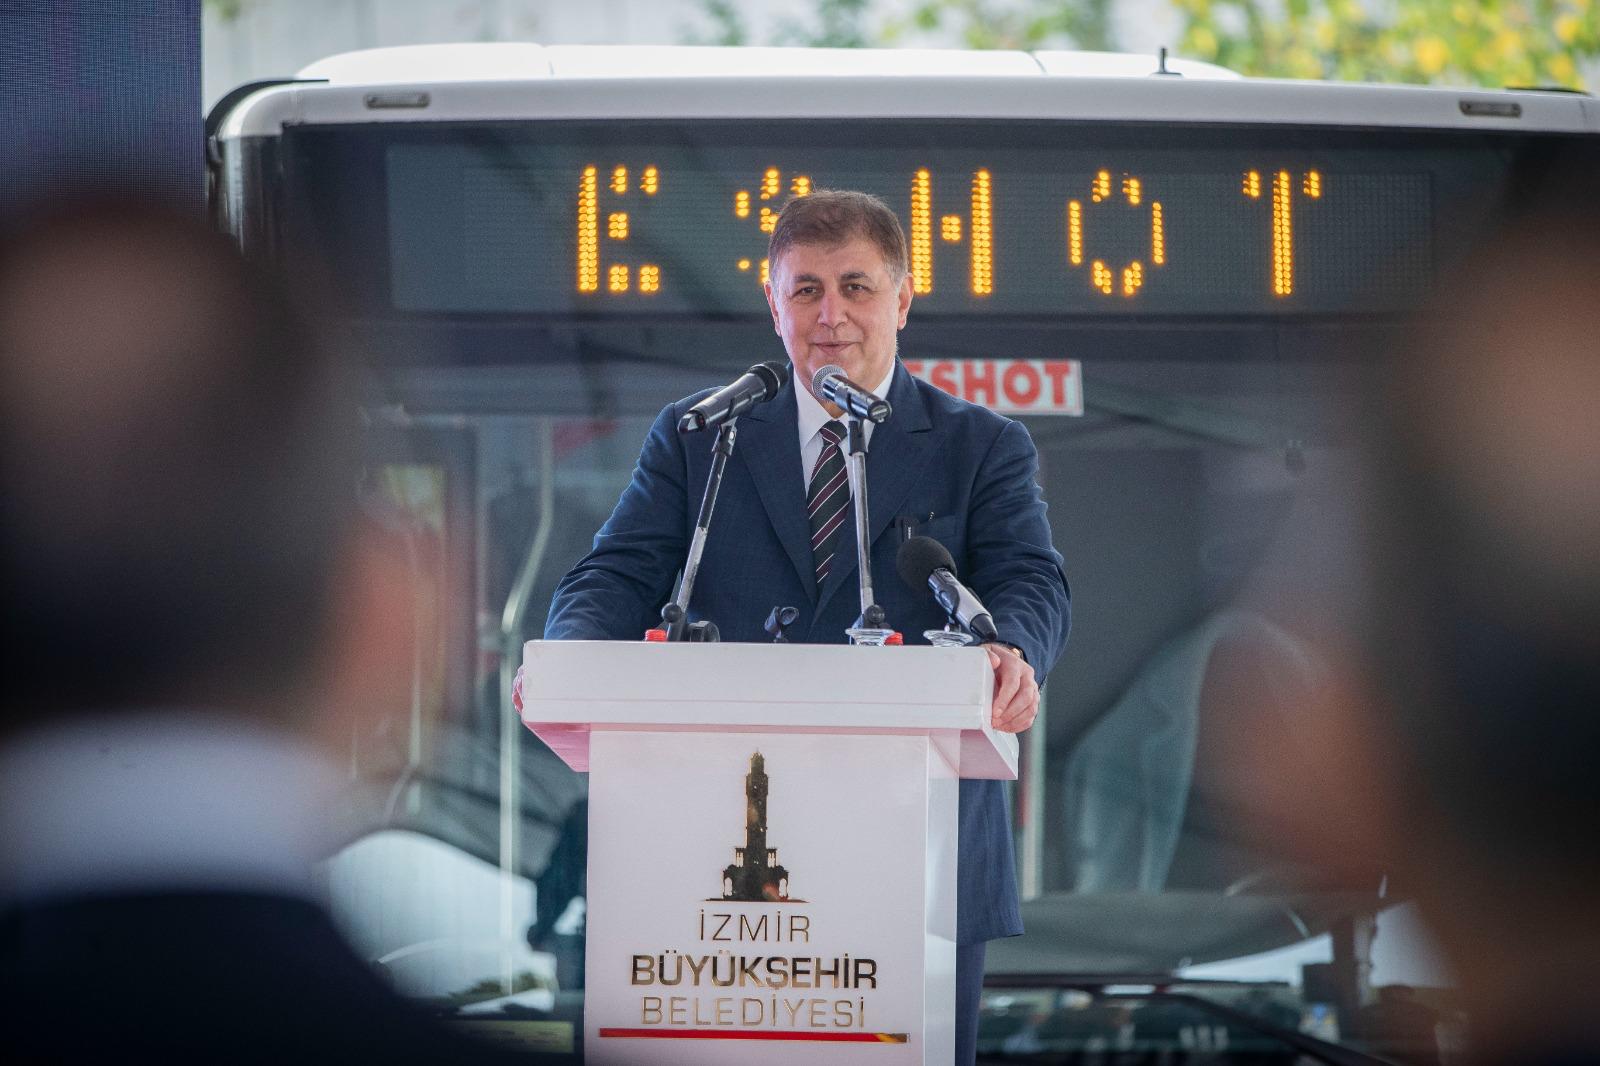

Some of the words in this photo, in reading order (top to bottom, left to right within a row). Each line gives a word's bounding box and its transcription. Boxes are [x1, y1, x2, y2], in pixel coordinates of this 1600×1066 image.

[902, 360, 1070, 406] SHOT
[699, 909, 811, 942] İZMİR
[631, 949, 877, 991] BÜYÜKŞEHİR
[641, 993, 865, 1028] BELEDİYESİ
